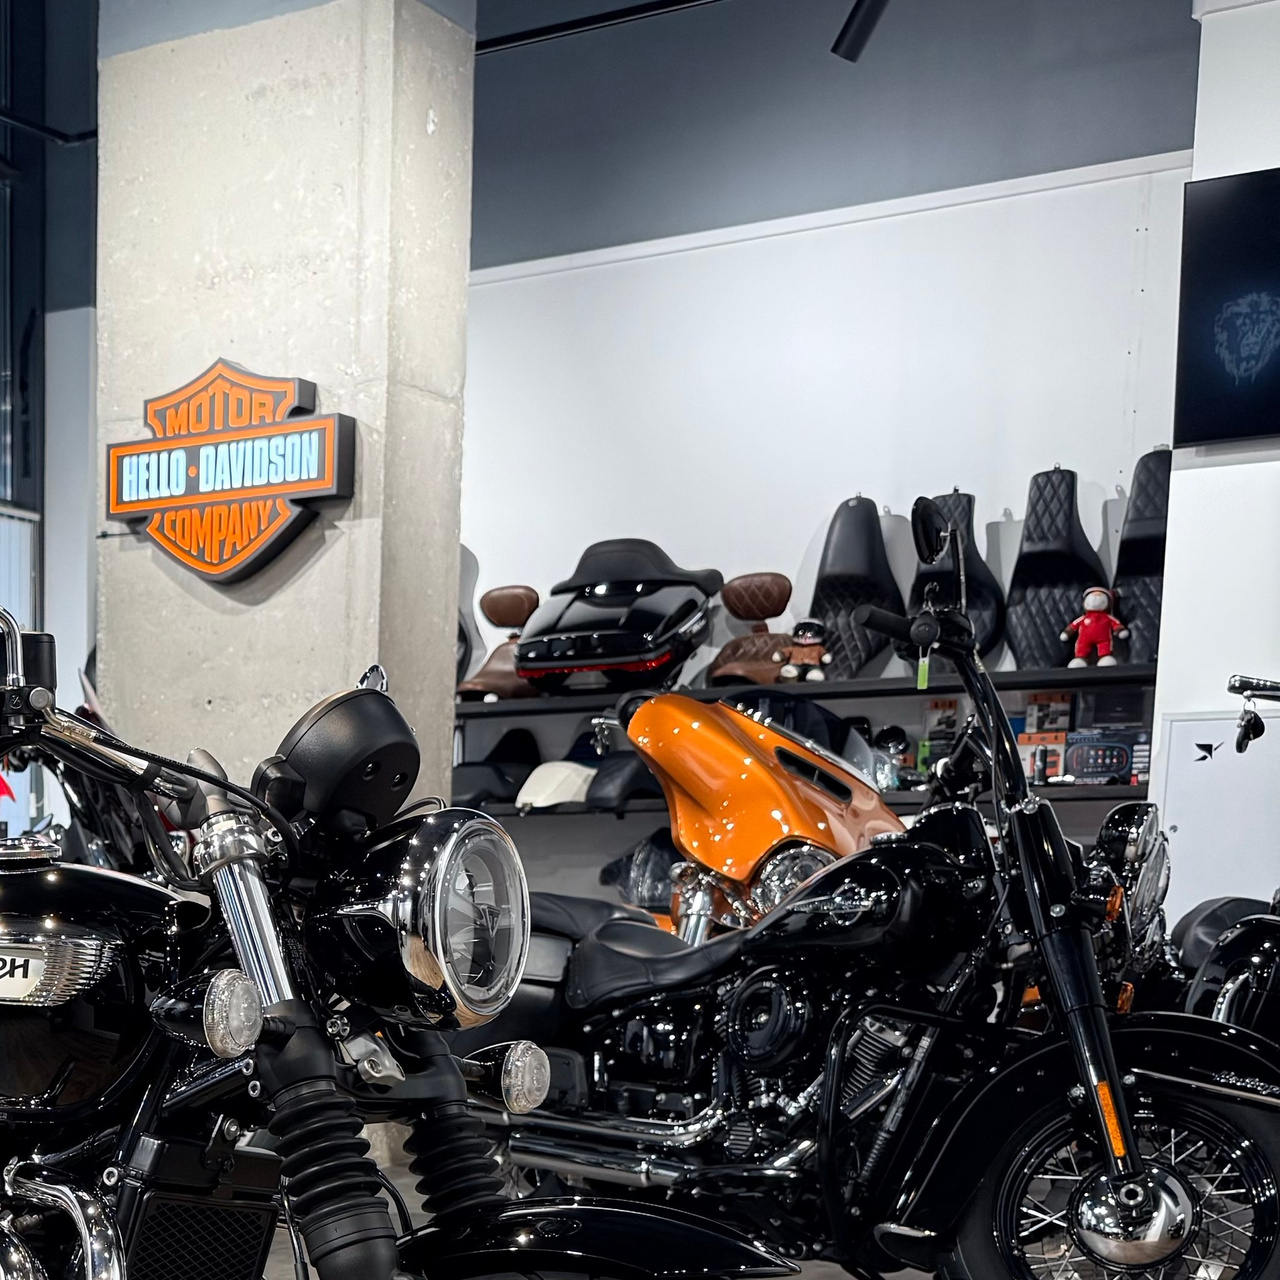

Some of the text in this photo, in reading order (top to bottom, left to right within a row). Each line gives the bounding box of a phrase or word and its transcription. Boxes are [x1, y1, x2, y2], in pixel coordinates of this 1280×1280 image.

[166, 378, 275, 437] MOTOR
[123, 431, 319, 501] HELLO DAVIDSON
[164, 499, 274, 563] COMPANY
